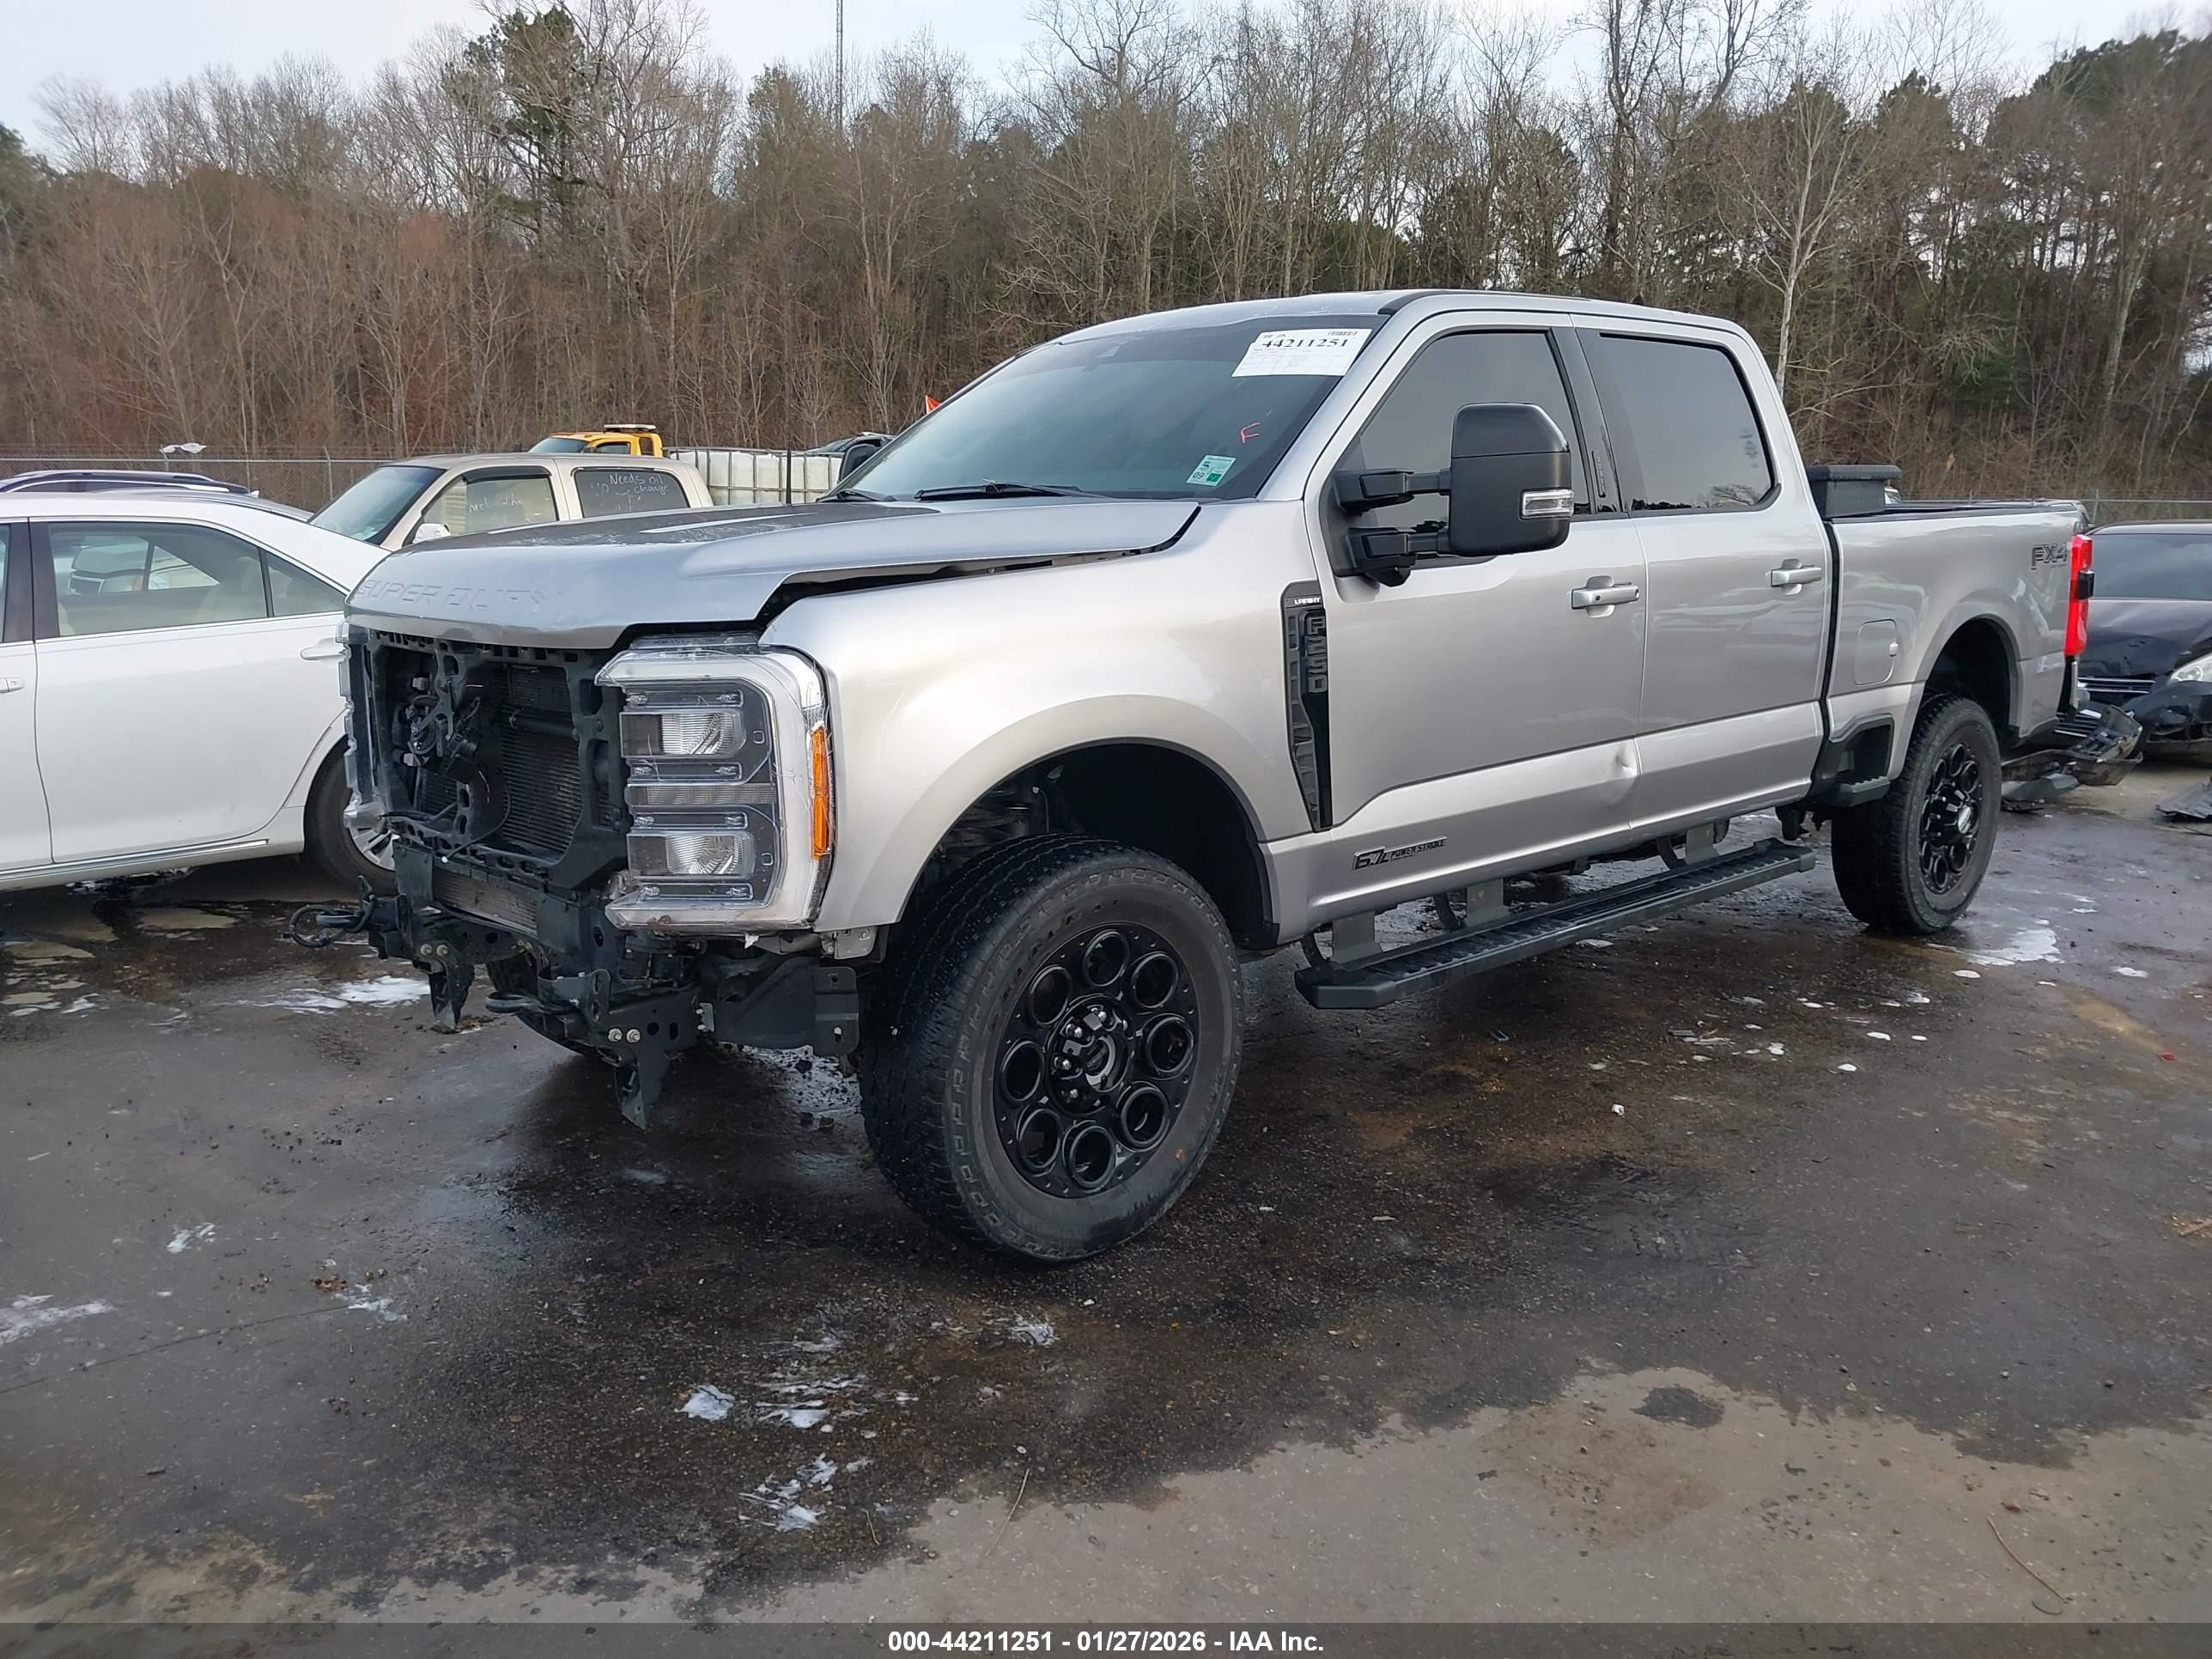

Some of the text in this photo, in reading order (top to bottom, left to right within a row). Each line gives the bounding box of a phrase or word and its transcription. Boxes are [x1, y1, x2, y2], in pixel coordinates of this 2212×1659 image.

[1261, 338, 1349, 348] 44211251
[610, 473, 645, 485] Needs
[634, 483, 669, 495] change
[2030, 544, 2068, 570] FX4
[356, 580, 442, 605] SUPER
[1354, 848, 1389, 870] 6.7L
